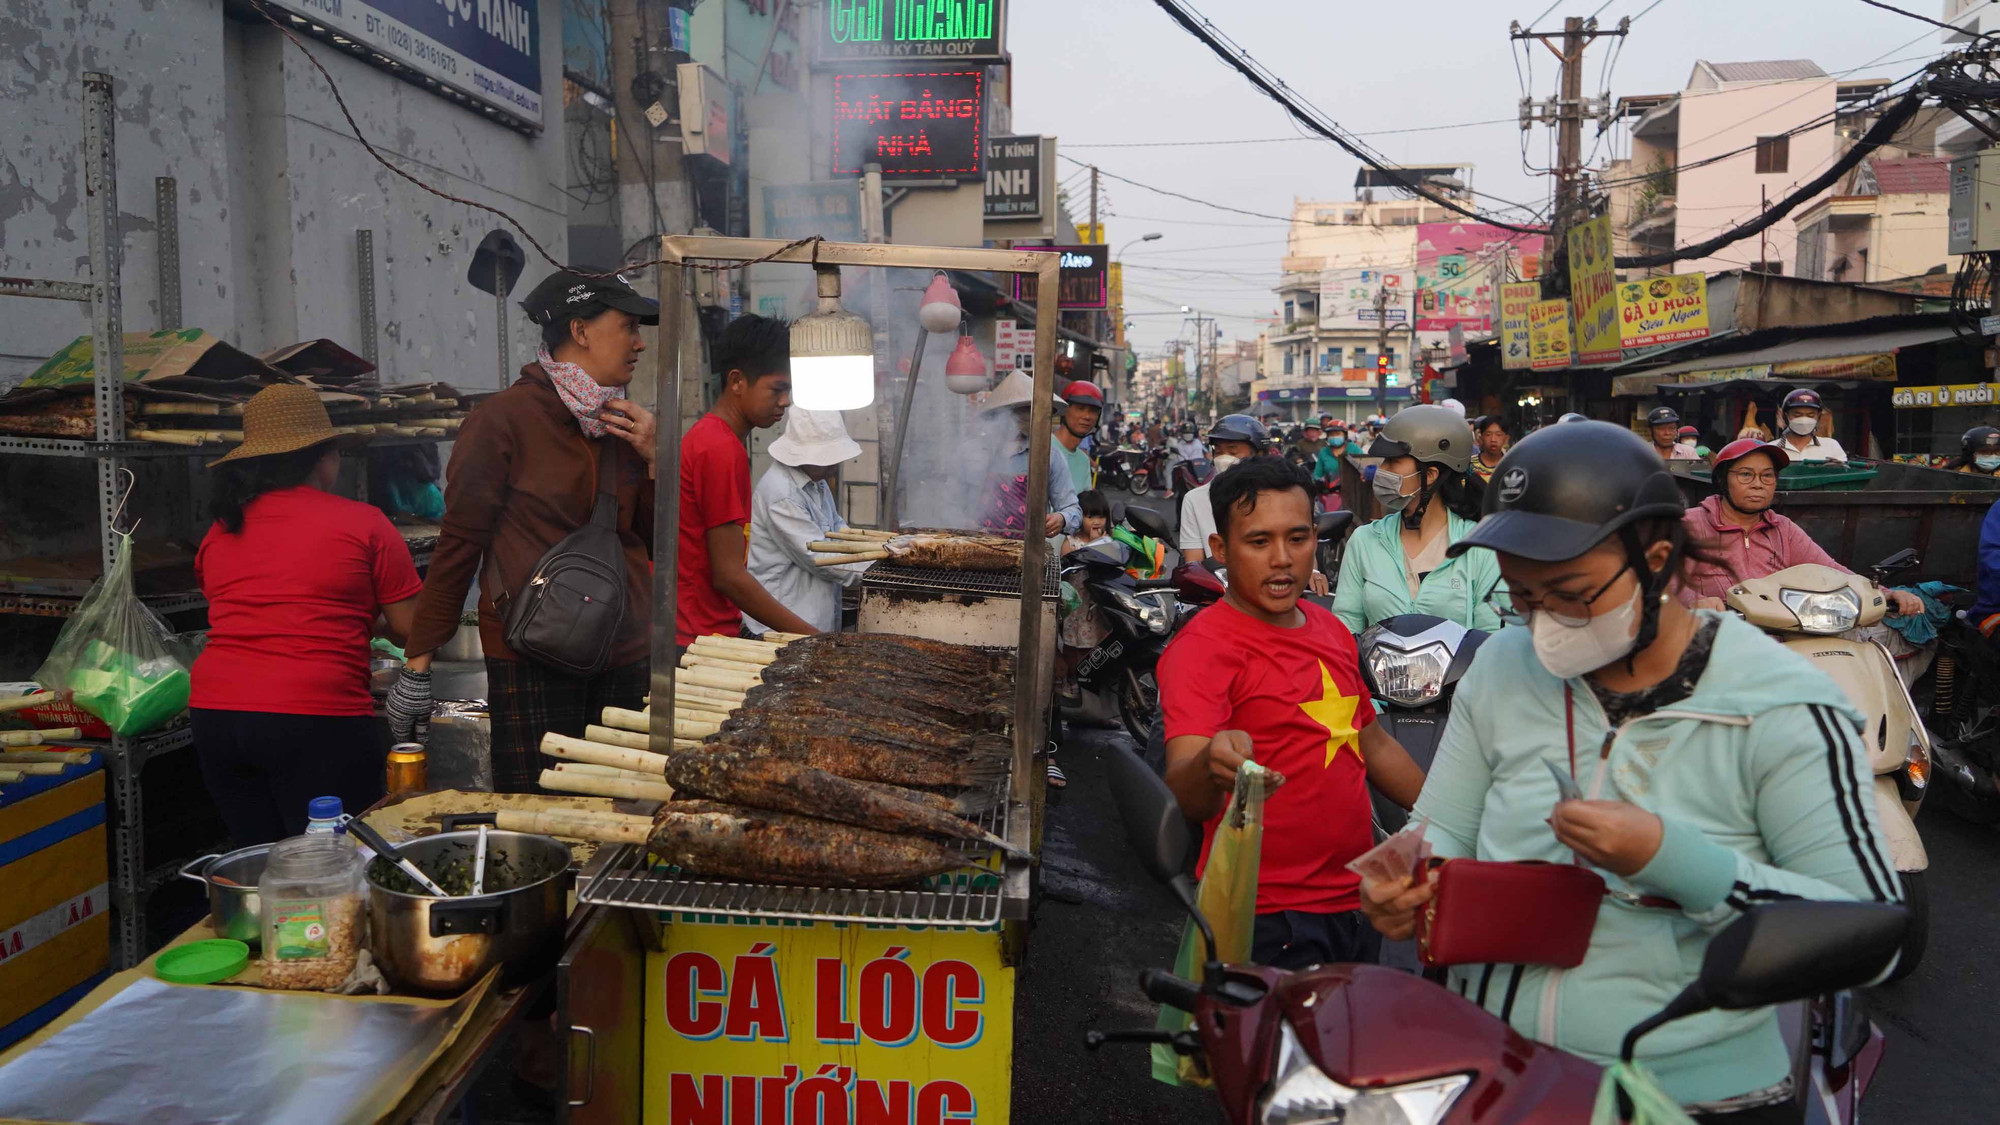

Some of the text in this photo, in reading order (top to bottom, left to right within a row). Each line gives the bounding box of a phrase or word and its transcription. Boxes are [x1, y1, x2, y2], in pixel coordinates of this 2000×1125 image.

[366, 13, 385, 38] ĐT:
[388, 24, 412, 56] (028)
[414, 38, 457, 75] 38161673
[915, 40, 943, 55] TÂN
[900, 88, 973, 120] BẰNG
[878, 128, 932, 156] NHÀ
[1005, 142, 1035, 158] KÍNH
[1504, 303, 1526, 316] QU
[1623, 293, 1701, 324] GÀ Ủ MUỐI
[1638, 308, 1702, 334] Siêu Ngon
[1938, 385, 1950, 405] Ủ
[1954, 381, 1994, 404] MUỐI
[665, 942, 985, 1050] CÁ LÓC
